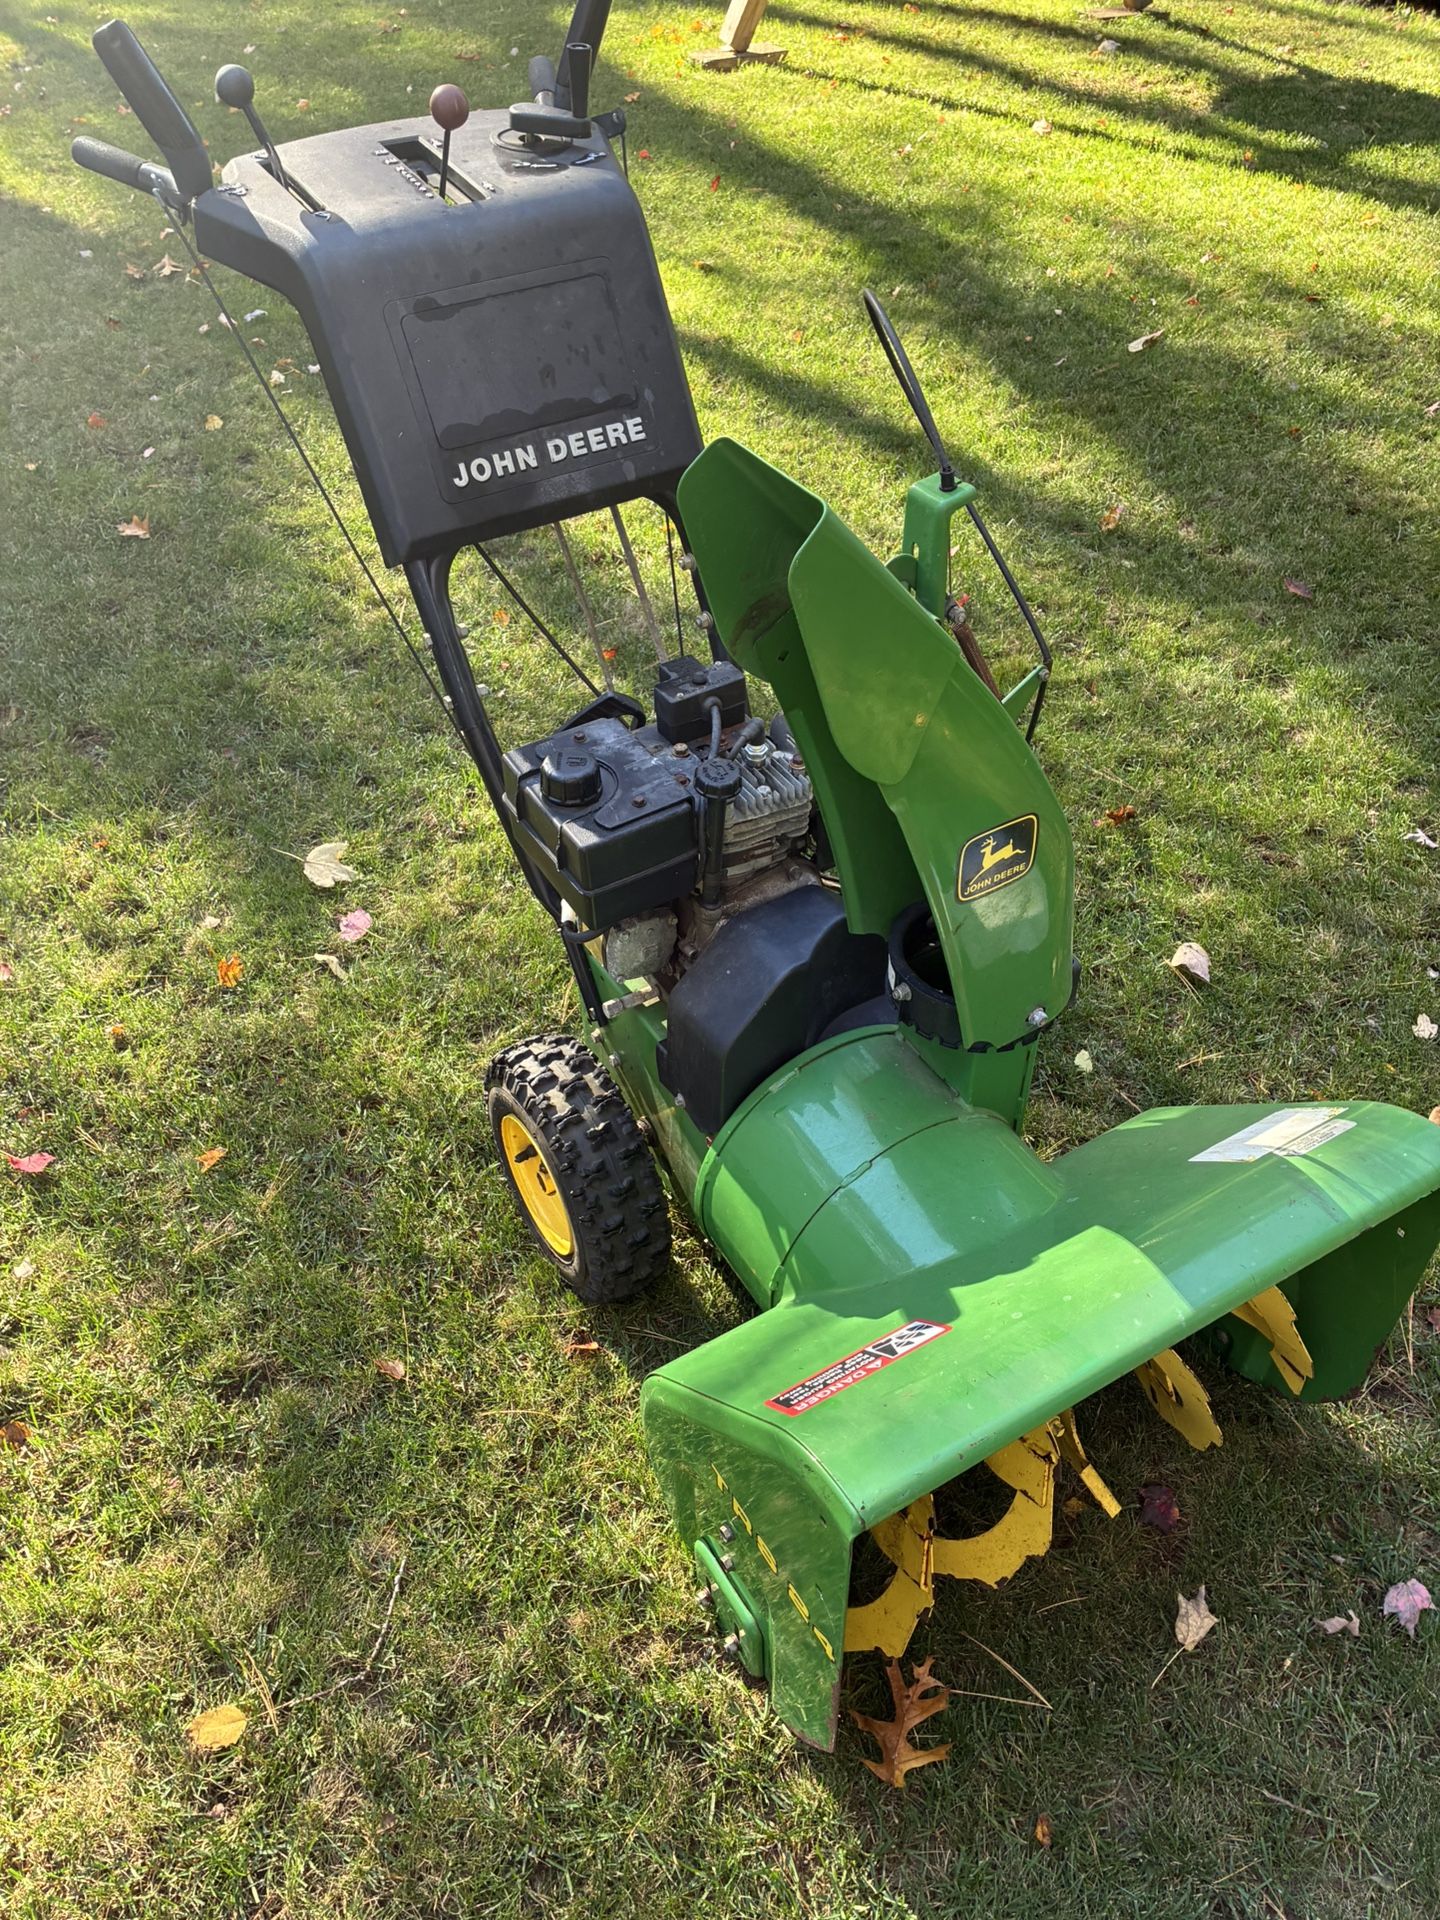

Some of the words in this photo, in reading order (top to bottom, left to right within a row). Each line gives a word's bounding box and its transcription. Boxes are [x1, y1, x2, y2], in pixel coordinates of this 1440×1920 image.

[453, 444, 538, 488] JOHN
[547, 416, 647, 463] DEERE
[964, 877, 992, 895] JOHN
[994, 862, 1026, 883] DEERE
[826, 1356, 875, 1384] ROTATING
[790, 1384, 823, 1404] AUGER
[793, 1370, 867, 1410] DANGER
[711, 1462, 778, 1575] TRS
[787, 1582, 835, 1663] 24
